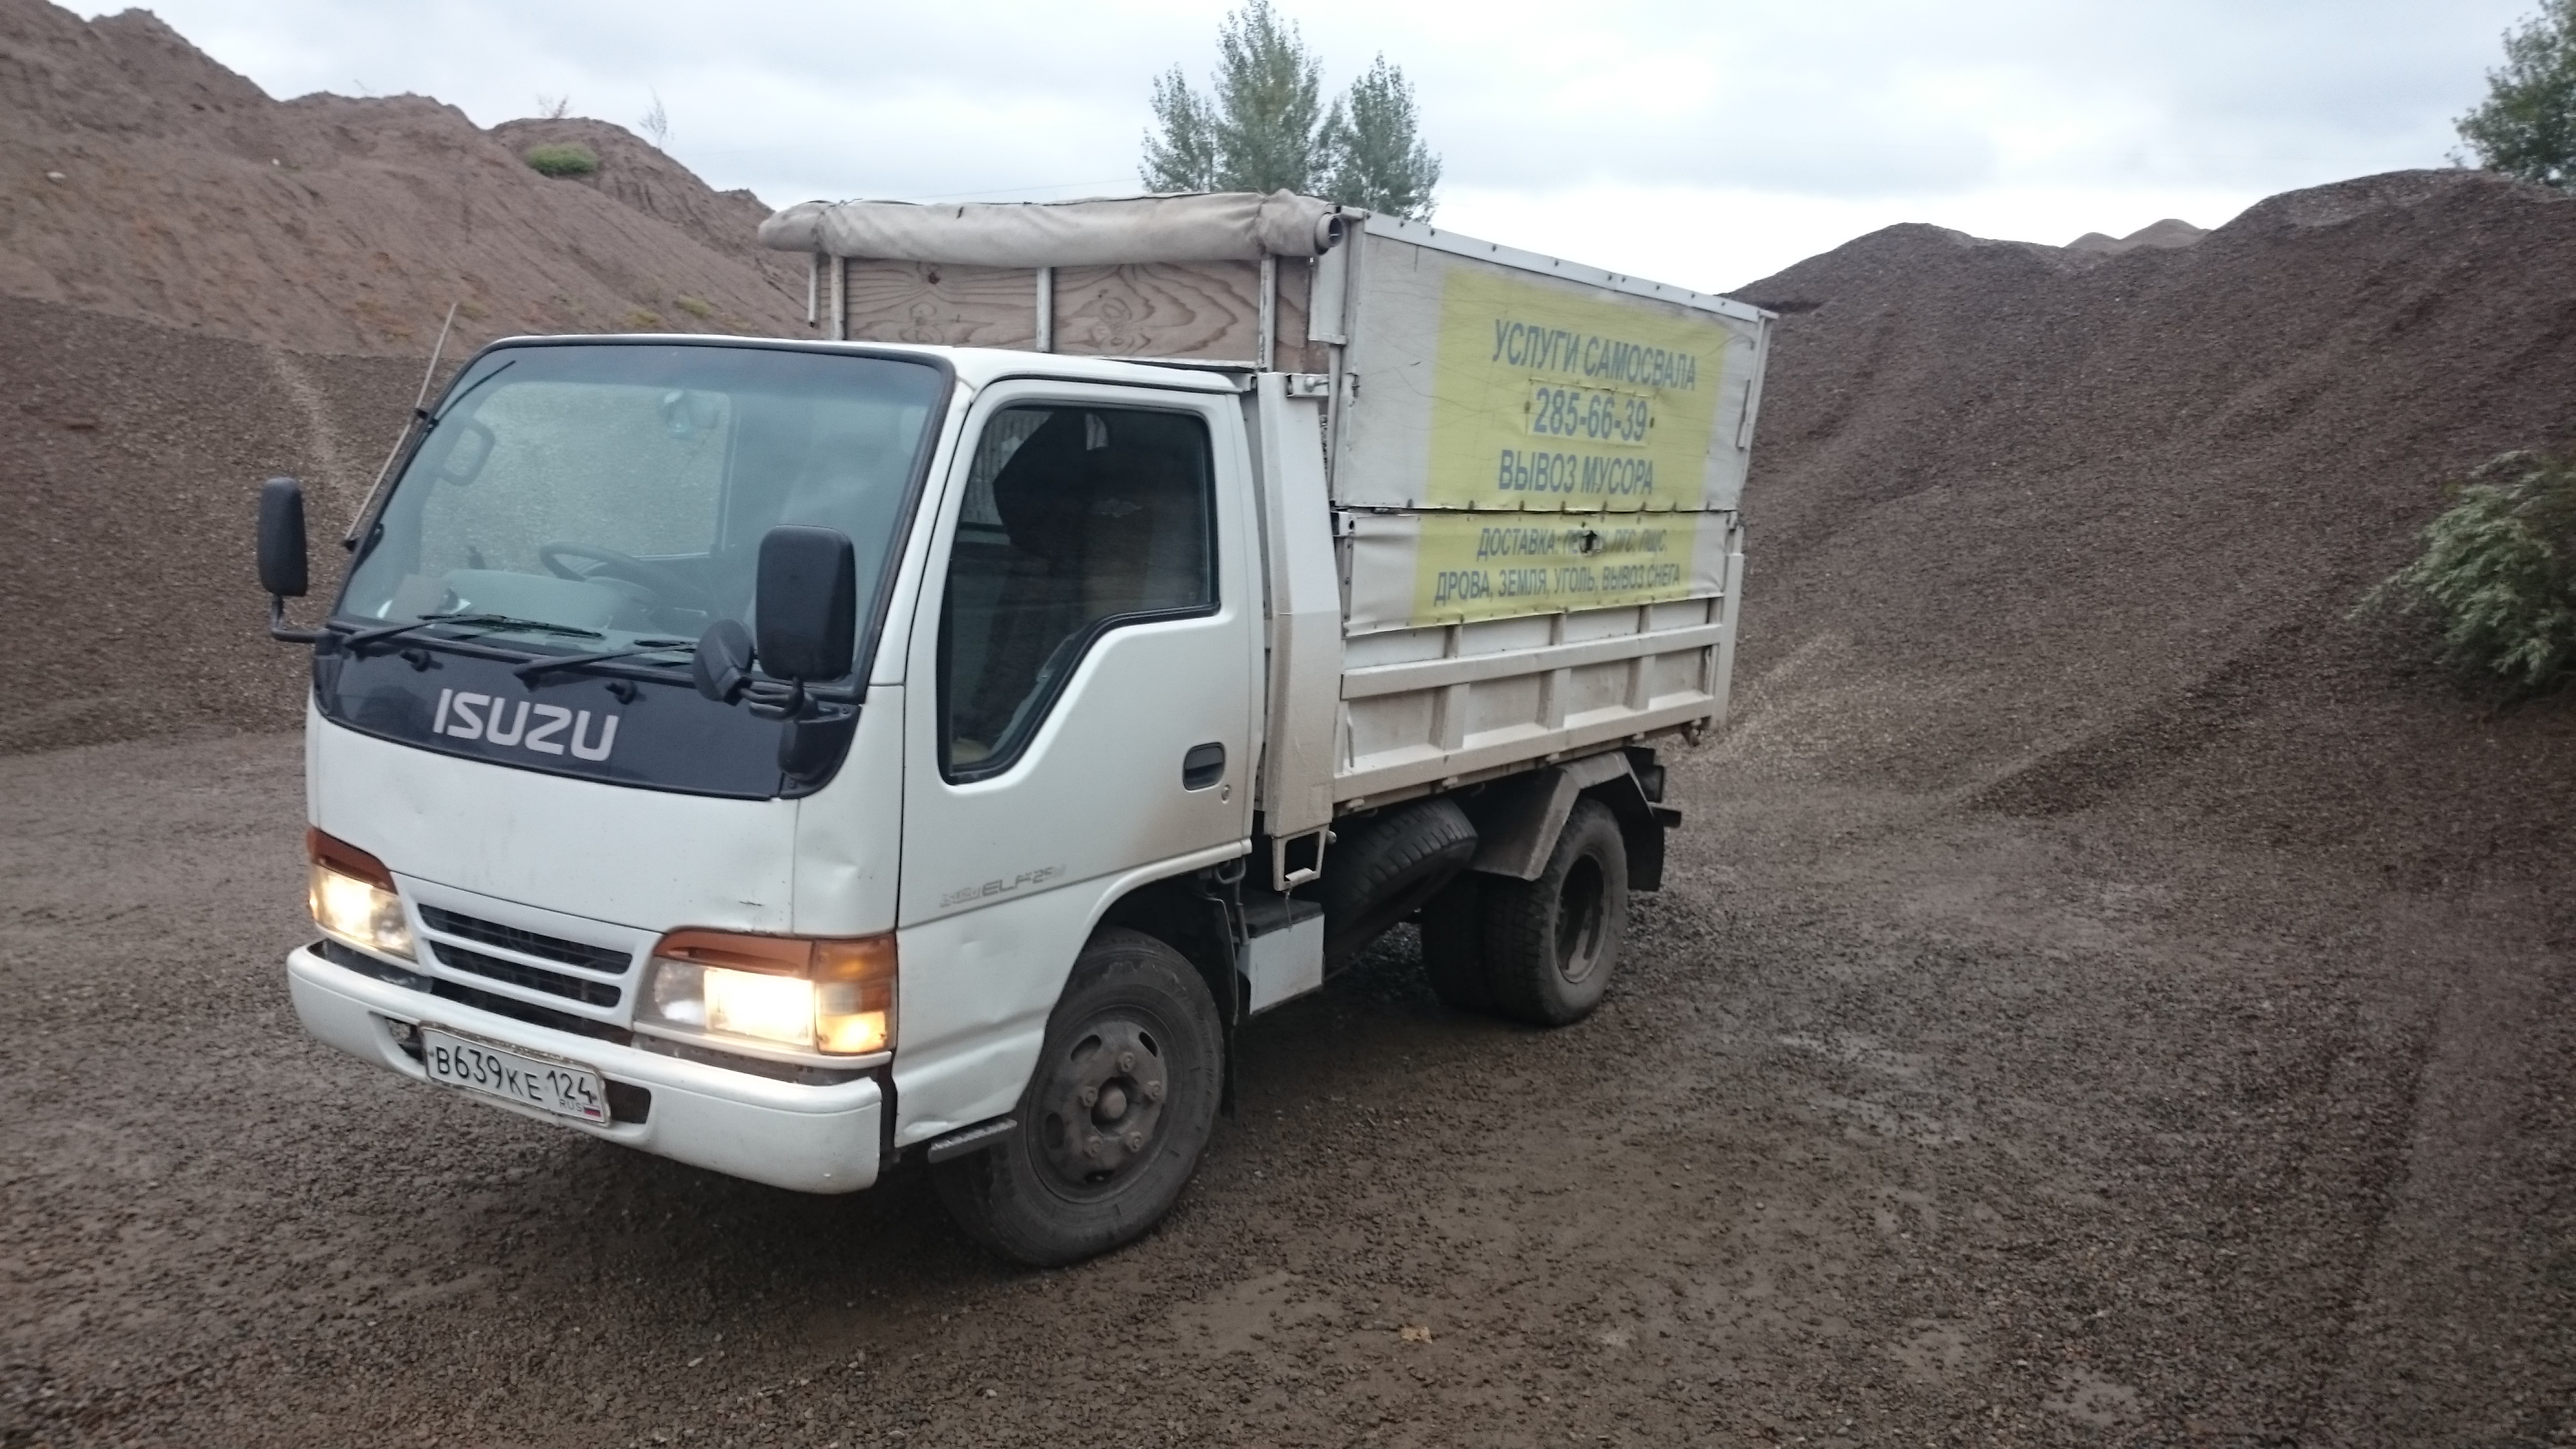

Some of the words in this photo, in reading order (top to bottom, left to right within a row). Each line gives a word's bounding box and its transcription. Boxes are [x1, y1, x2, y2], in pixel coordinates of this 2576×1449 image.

[1492, 319, 1580, 373] УСЛУГИ
[1584, 336, 1696, 390] САМОСВАЛА
[1533, 387, 1648, 441] 285-66-39
[1498, 449, 1576, 493] ВЫВОЗ
[1580, 455, 1654, 495] МУСОРА
[1434, 570, 1493, 607] ДРОВА,
[1498, 568, 1550, 599] ЗЕМЛЯ,
[1554, 566, 1598, 595] УГОЛЬ,
[1602, 565, 1645, 591] ВЫВОЗ
[1647, 563, 1680, 588] СНЕГА
[433, 688, 620, 762] ISUZU
[546, 1069, 593, 1104] 124
[559, 1098, 582, 1112] RUS
